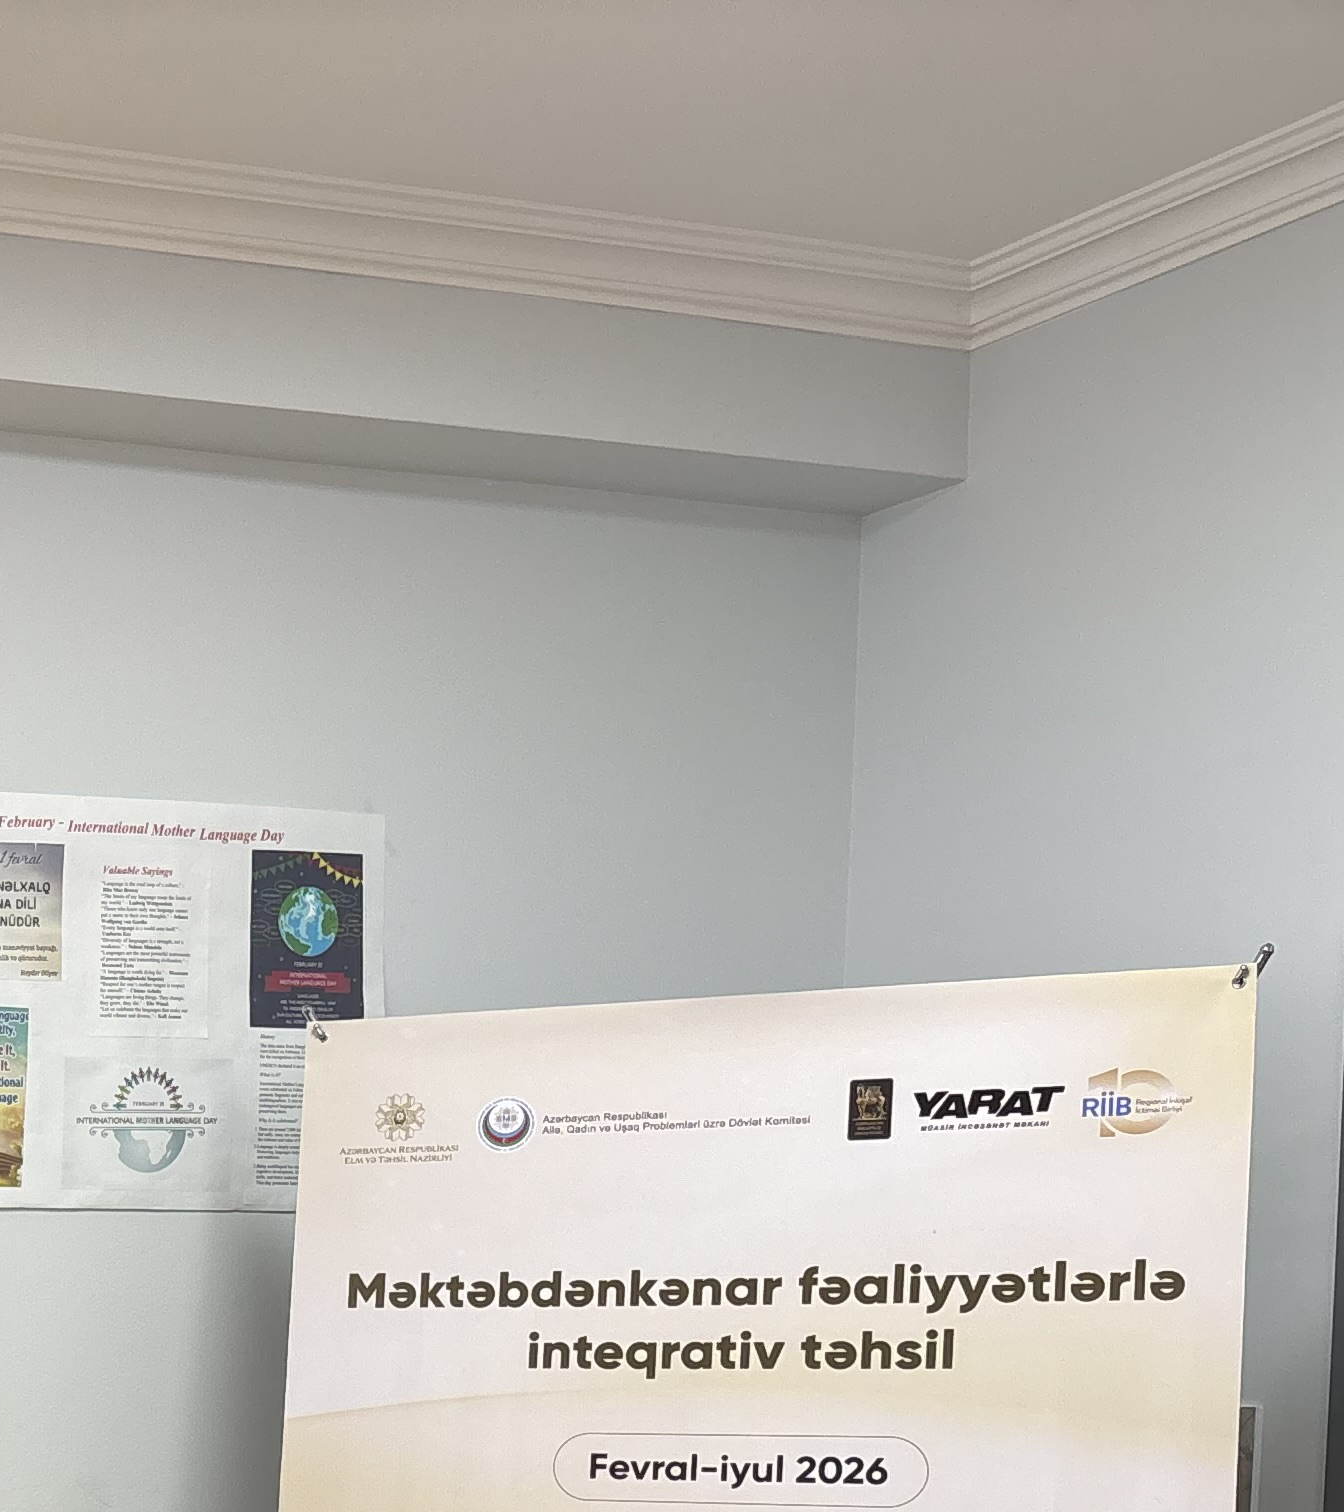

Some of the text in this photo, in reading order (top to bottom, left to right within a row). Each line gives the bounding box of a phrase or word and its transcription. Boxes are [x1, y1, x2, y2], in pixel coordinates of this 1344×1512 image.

[68, 820, 149, 835] International
[151, 823, 195, 838] Mother
[199, 828, 256, 844] Language
[260, 828, 284, 844] Day
[103, 866, 173, 878] Valuable Sayings
[16, 897, 36, 910] DİLİ
[914, 1085, 1065, 1120] YARAT
[347, 1260, 1186, 1313] Məktəbdənkənar fəaliyyətlərlə
[527, 1329, 954, 1378] inteqrativ təhsil
[796, 1455, 888, 1486] 2026
